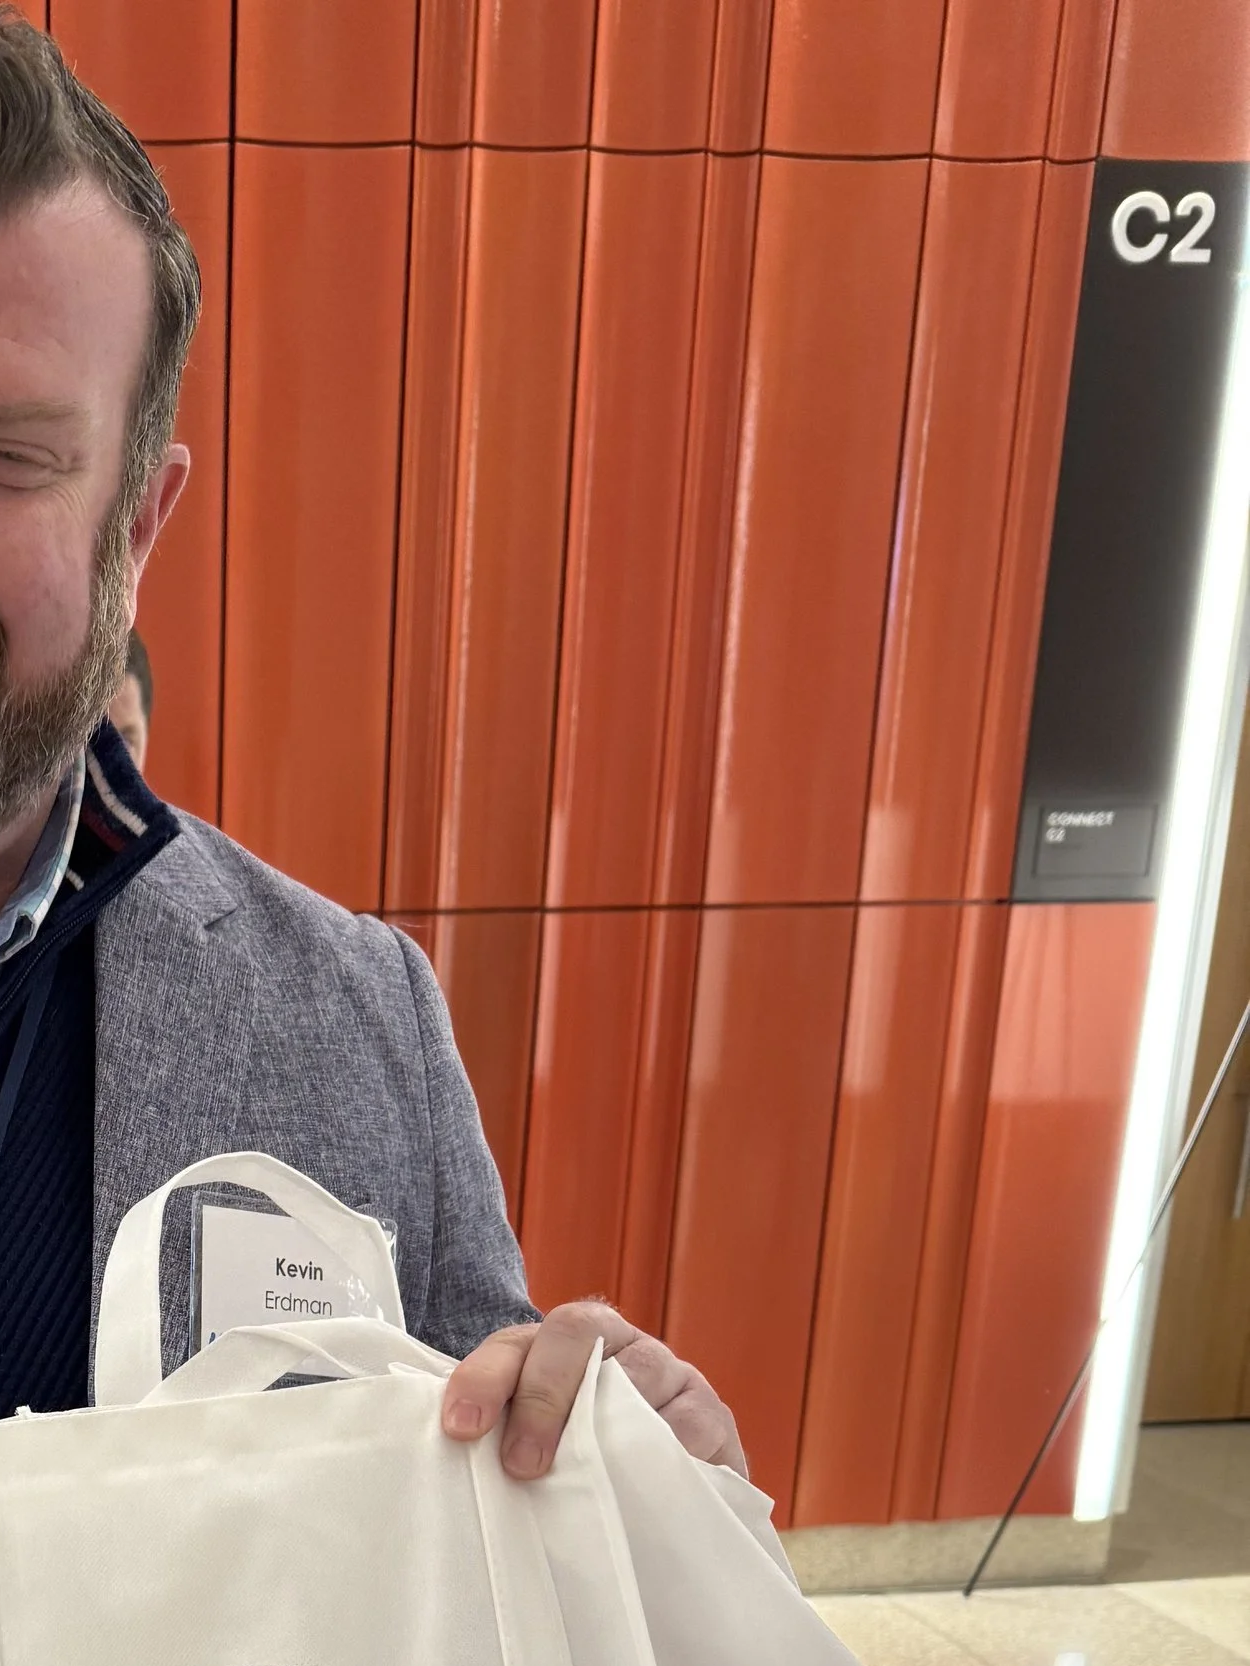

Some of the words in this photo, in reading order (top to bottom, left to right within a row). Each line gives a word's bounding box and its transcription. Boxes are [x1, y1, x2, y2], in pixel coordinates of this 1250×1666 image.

[1110, 190, 1217, 265] C2
[1047, 810, 1115, 827] CONNECT
[276, 1258, 323, 1281] Kevin
[265, 1291, 332, 1316] Erdman
